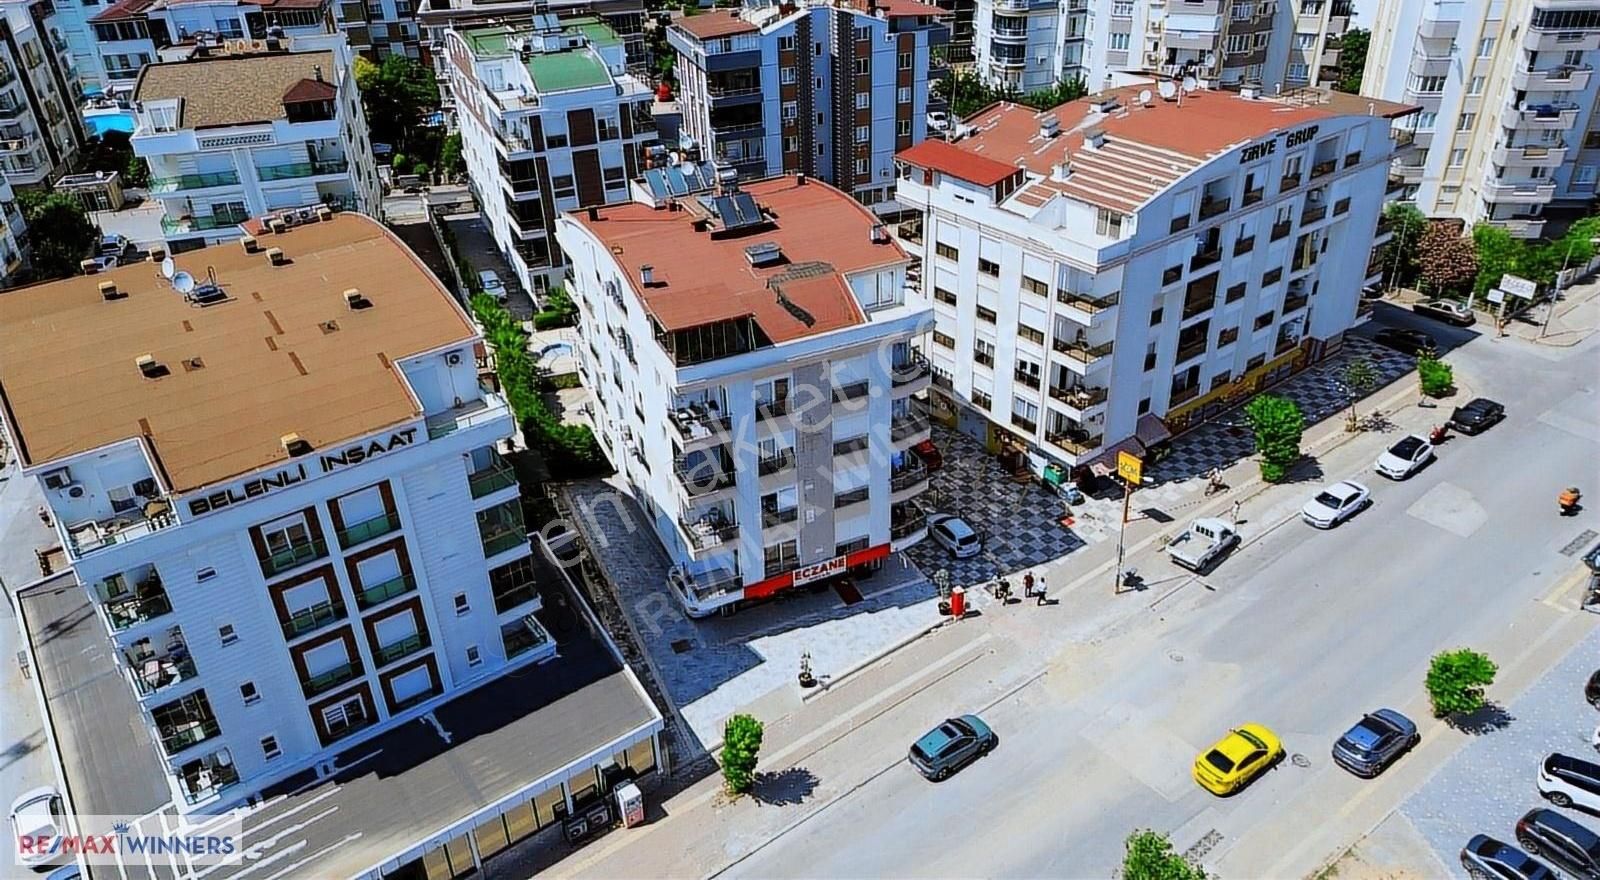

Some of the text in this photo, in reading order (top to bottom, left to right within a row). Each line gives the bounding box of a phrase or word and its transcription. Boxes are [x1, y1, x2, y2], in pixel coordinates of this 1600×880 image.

[1285, 124, 1320, 149] GRUP
[188, 463, 306, 517] BELENLI
[794, 557, 845, 581] ECZANE
